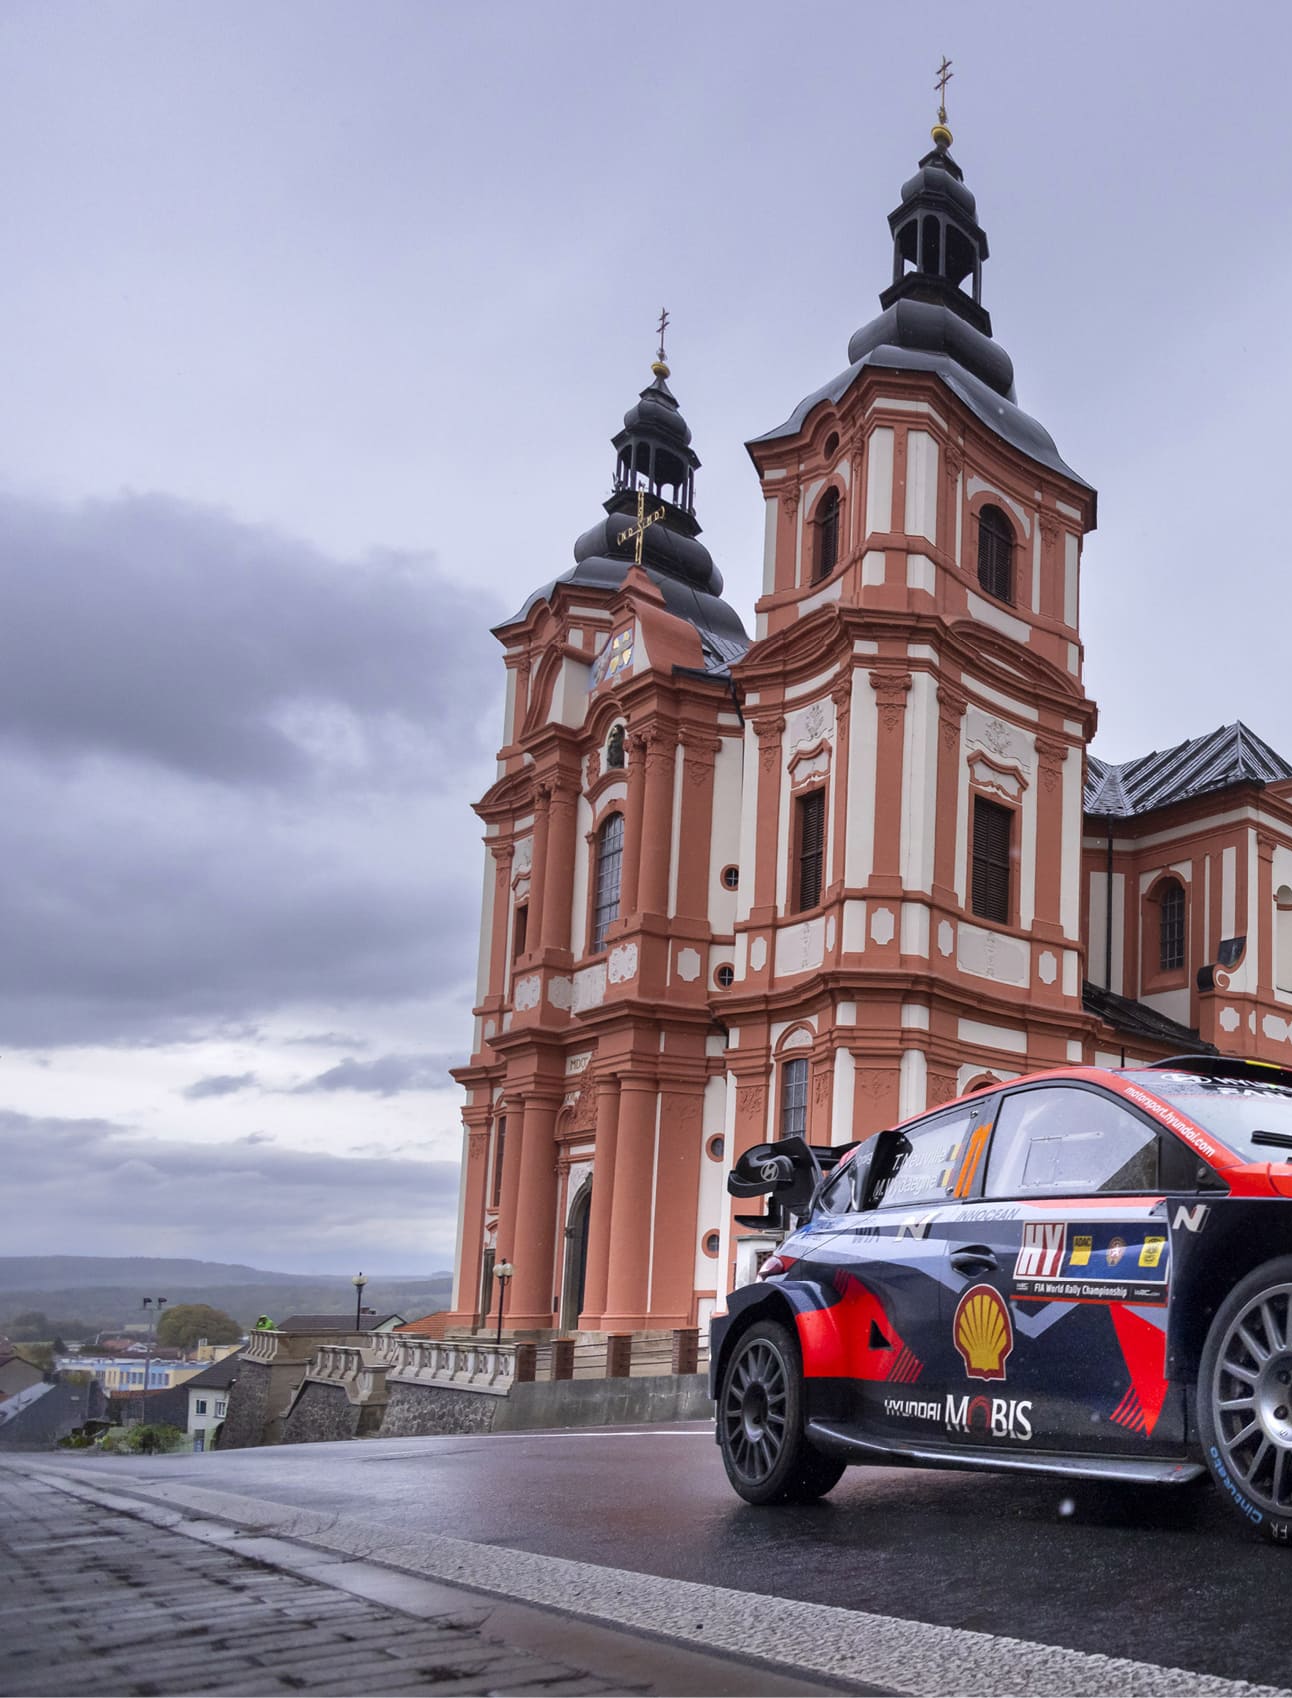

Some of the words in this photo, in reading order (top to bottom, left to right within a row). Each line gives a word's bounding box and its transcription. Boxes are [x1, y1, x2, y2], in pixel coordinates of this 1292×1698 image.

[1124, 1086, 1216, 1158] motorsport.hyundai.com
[957, 1207, 1021, 1222] INNOCEAN
[1018, 1224, 1064, 1275] HY
[1034, 1283, 1045, 1293] FIA
[1046, 1283, 1065, 1294] World
[1065, 1284, 1082, 1297] Rally
[1082, 1285, 1128, 1298] Championship
[884, 1398, 941, 1421] HYUNDAI
[945, 1394, 1033, 1441] MOBIS
[1210, 1446, 1263, 1524] Cinturato
